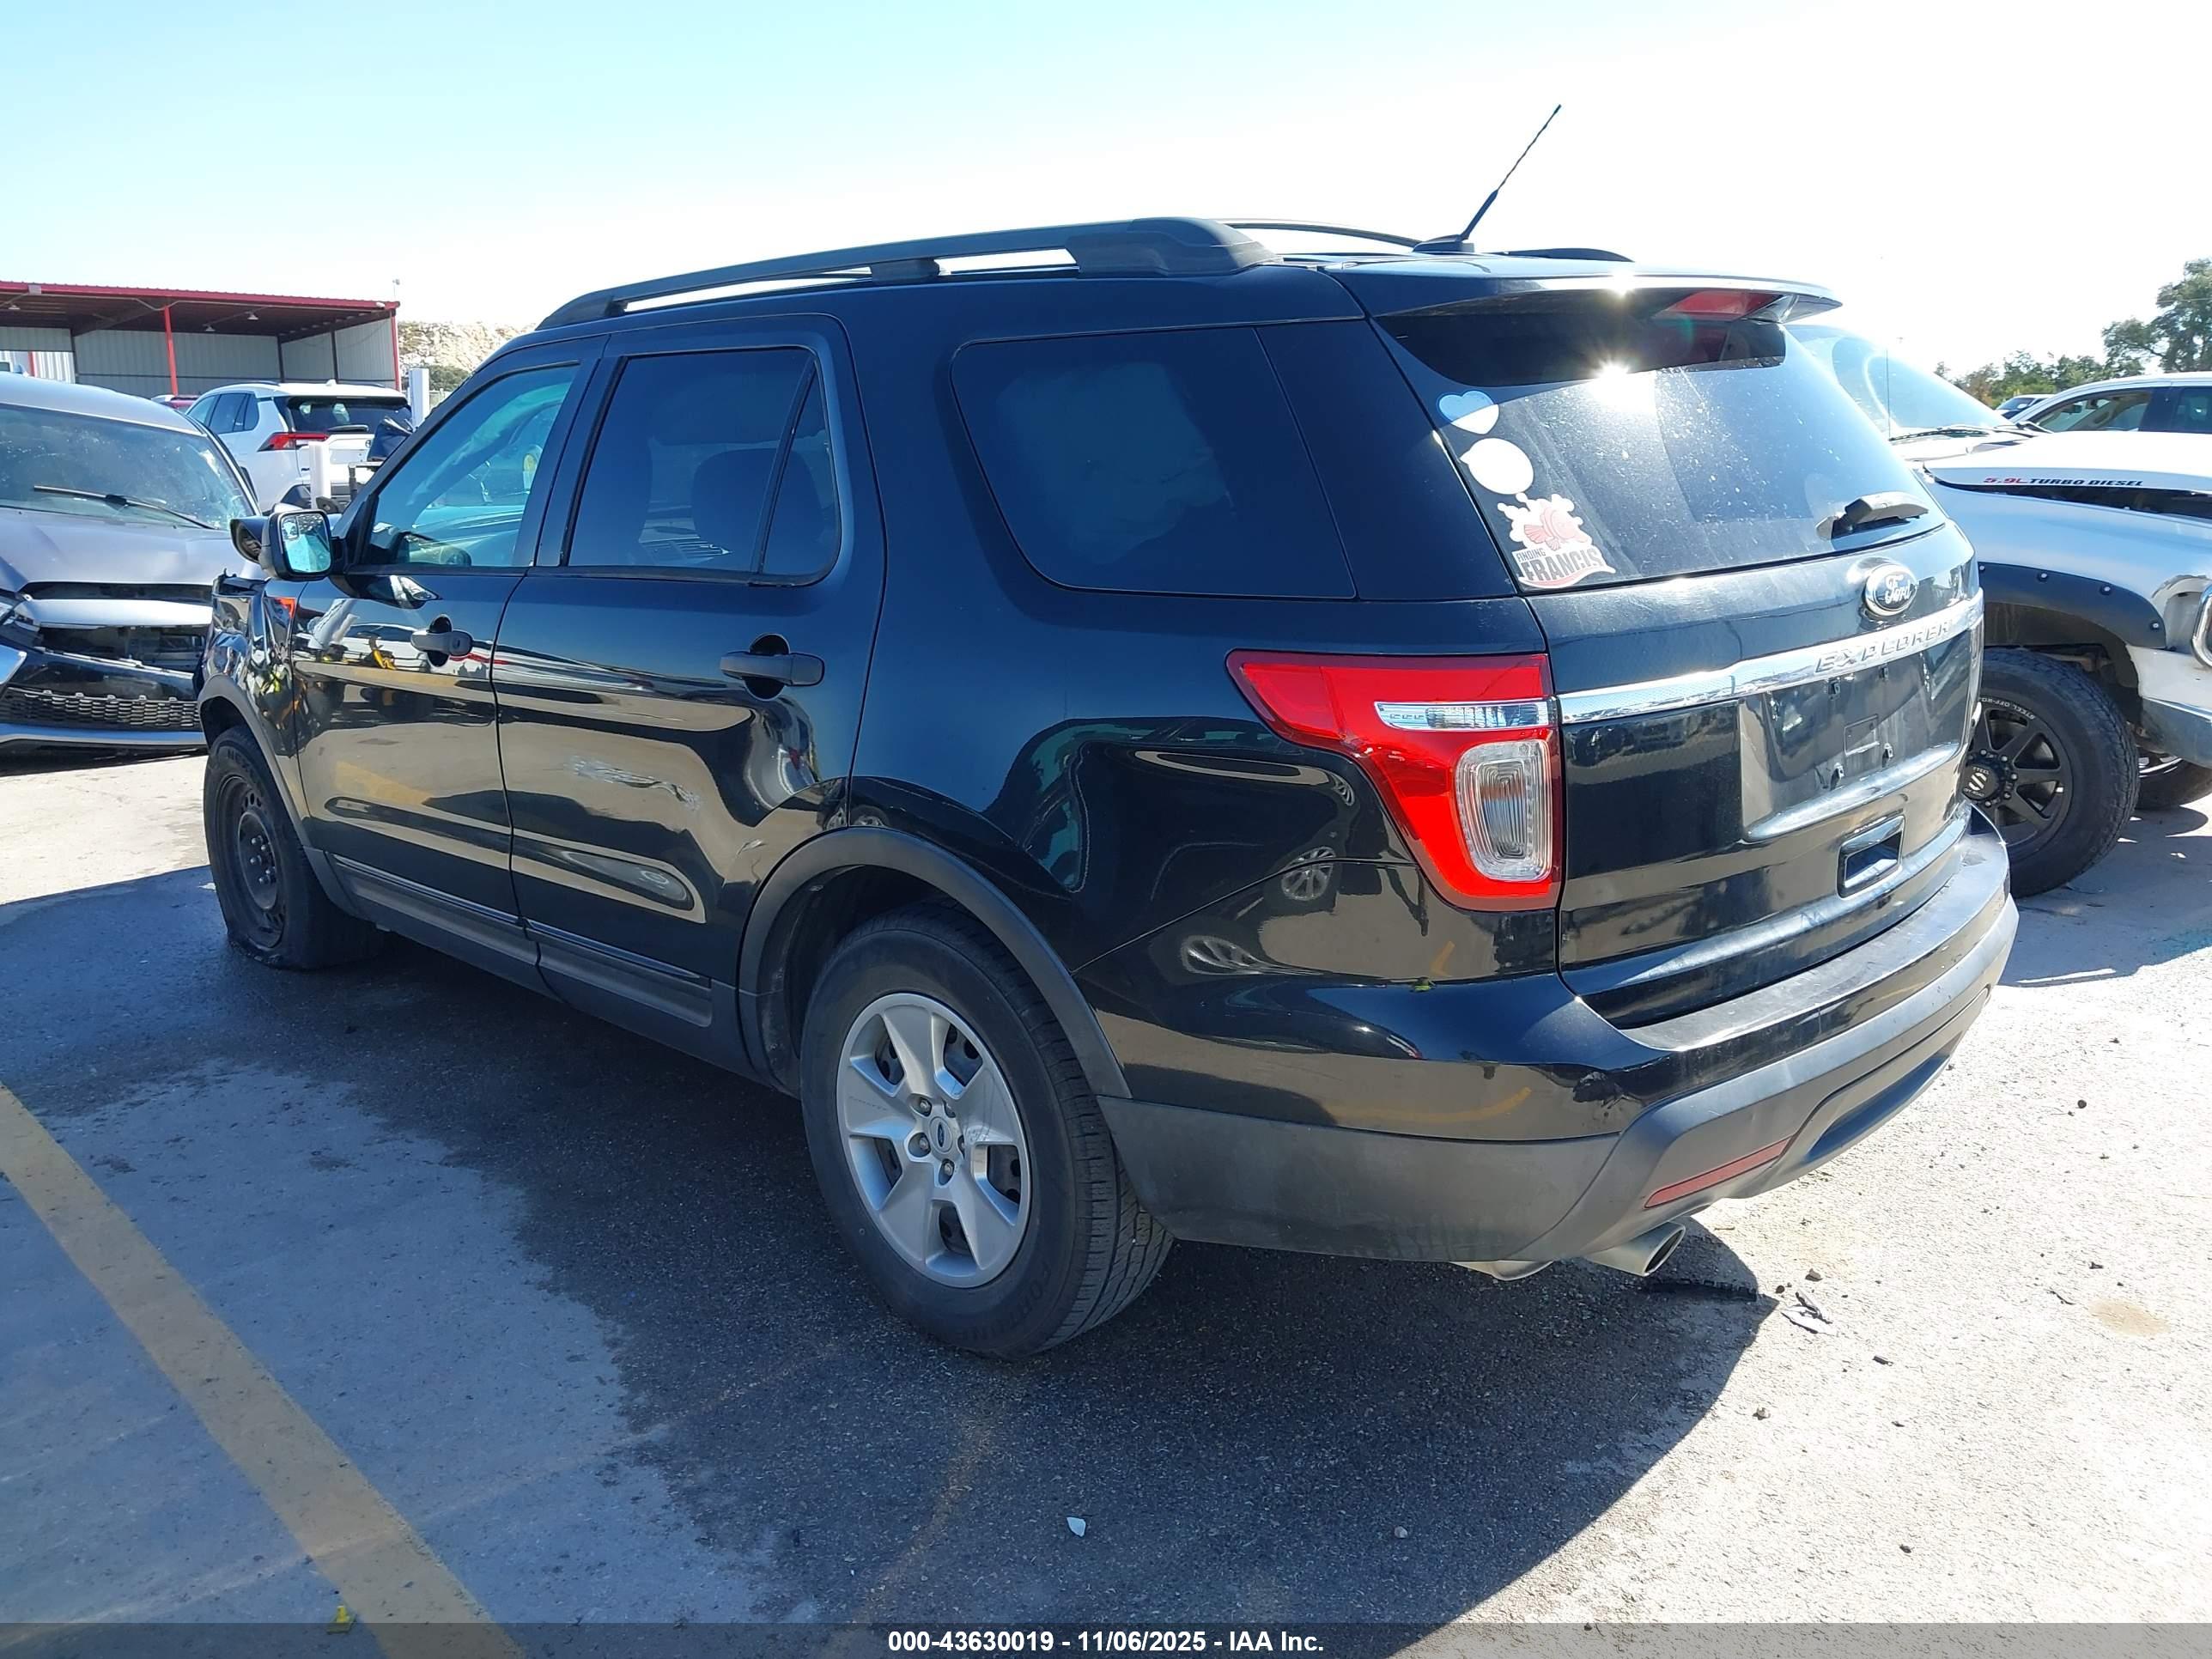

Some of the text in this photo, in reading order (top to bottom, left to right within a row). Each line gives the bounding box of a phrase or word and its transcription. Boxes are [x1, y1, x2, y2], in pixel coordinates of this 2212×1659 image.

[1516, 548, 1547, 563] FINDING
[1520, 548, 1604, 581] FRANCIS
[1884, 574, 1916, 605] Ford
[1814, 618, 1954, 674] EXPLORER
